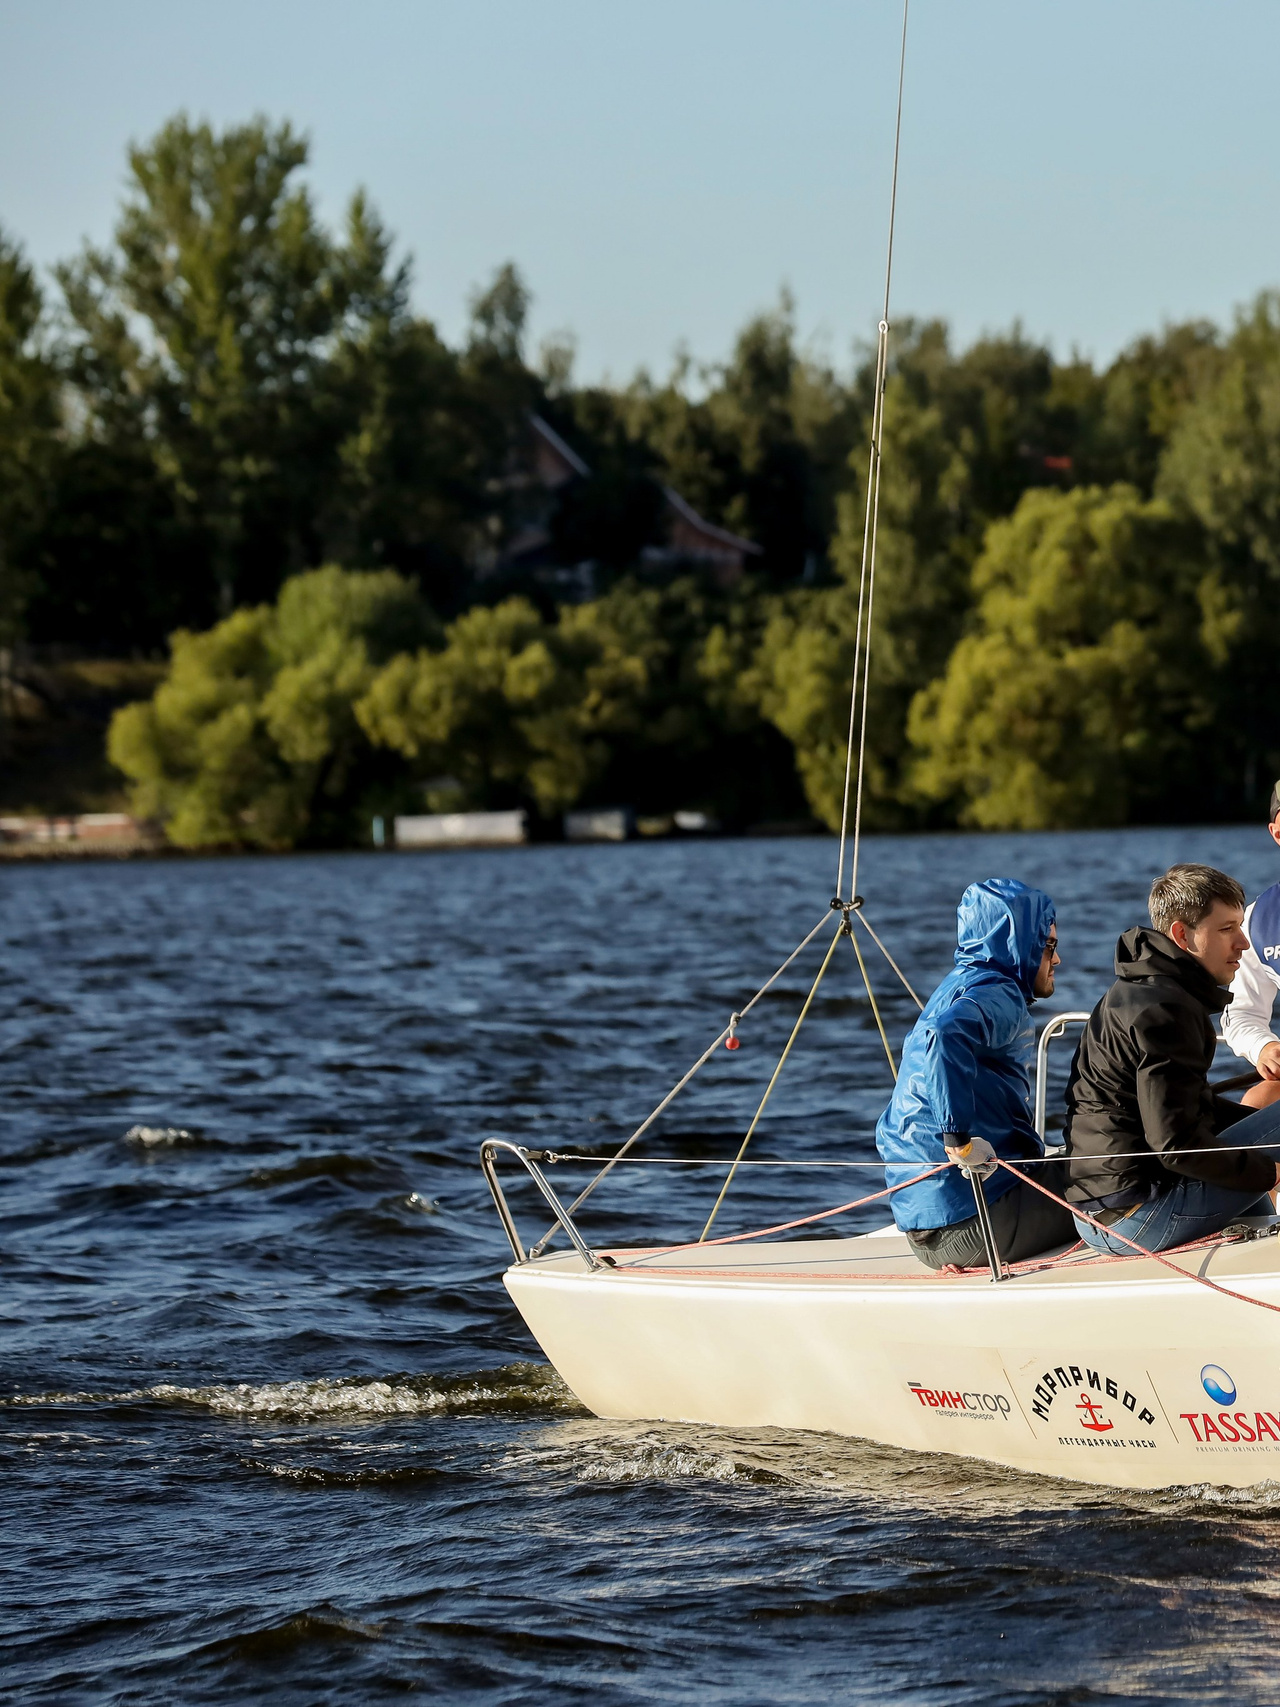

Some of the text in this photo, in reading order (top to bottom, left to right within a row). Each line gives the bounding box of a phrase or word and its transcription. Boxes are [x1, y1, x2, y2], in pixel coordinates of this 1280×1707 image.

[1032, 1365, 1156, 1425] МОРПРИБОР
[1058, 1437, 1157, 1448] ЛЕГЕНДАРНЫЕ ЧАСЫ
